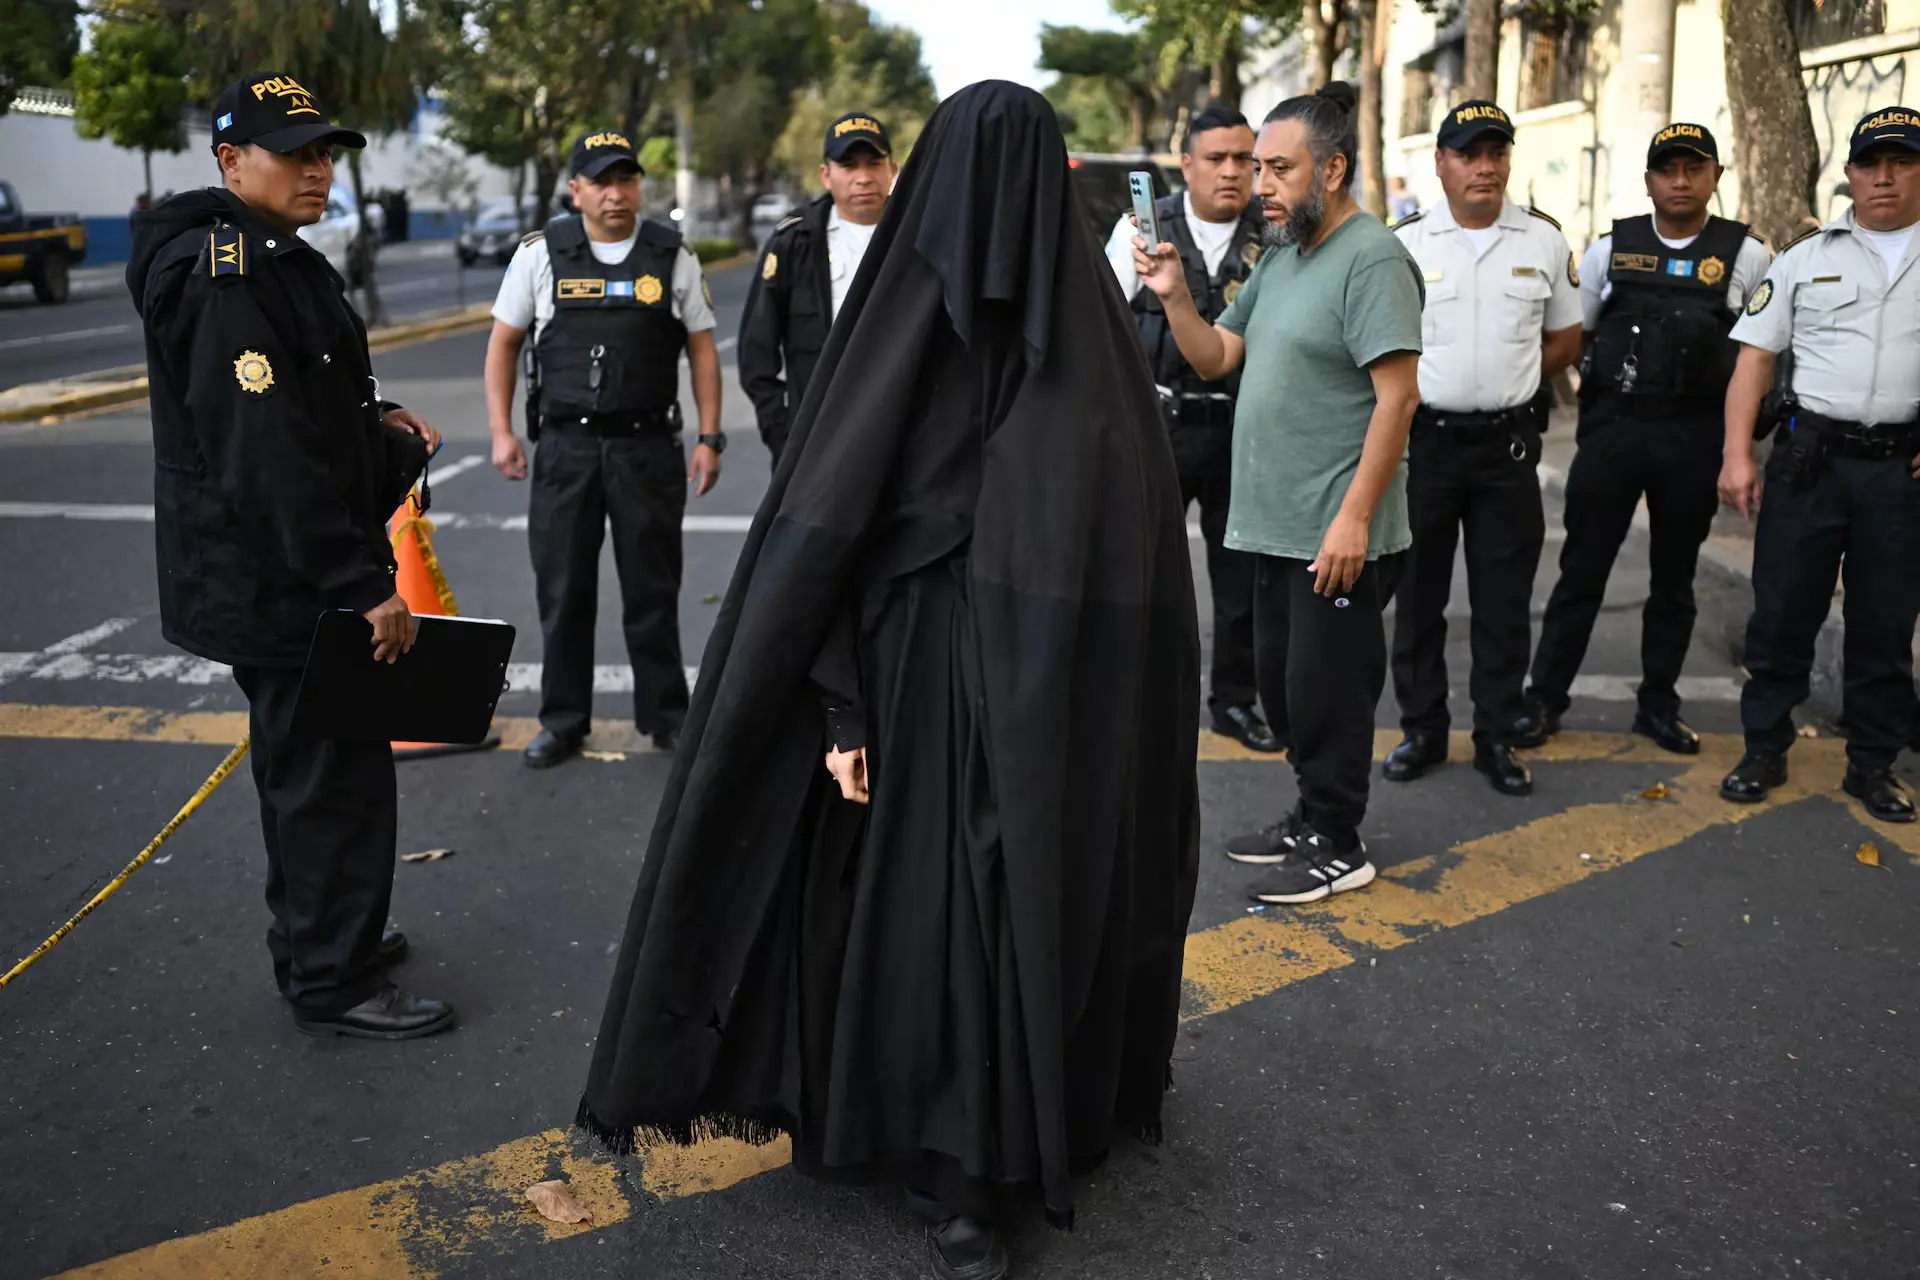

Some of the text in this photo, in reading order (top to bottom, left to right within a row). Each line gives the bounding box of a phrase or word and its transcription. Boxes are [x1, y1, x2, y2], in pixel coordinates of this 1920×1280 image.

[250, 75, 315, 101] POLI
[1456, 105, 1507, 125] POLICIA
[1858, 112, 1920, 135] POLICIA
[834, 117, 880, 138] POLICIA
[1655, 125, 1702, 145] POLICIA
[584, 132, 631, 150] POLICIA
